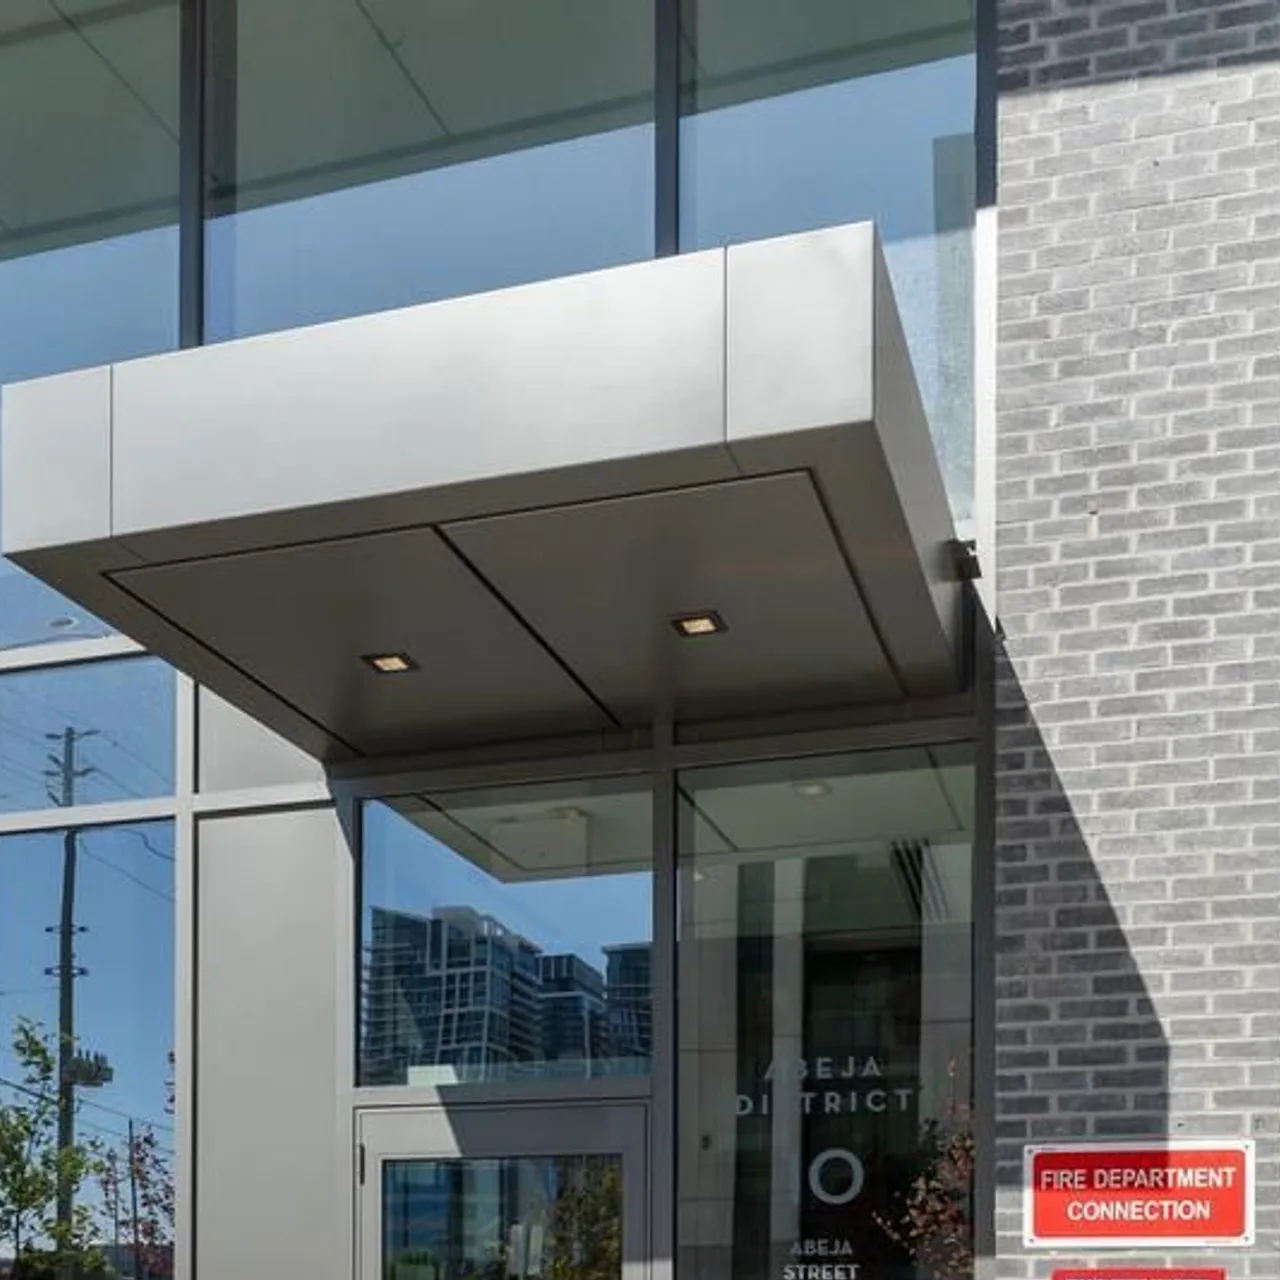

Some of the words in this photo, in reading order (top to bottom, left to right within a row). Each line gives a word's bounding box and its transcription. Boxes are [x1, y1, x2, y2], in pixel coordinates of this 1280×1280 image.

[735, 1089, 913, 1115] DITRICT
[1041, 1169, 1087, 1190] FIRE
[1094, 1167, 1236, 1189] DEPARTMENT
[1067, 1200, 1211, 1221] CONNECTION
[790, 1238, 853, 1256] ABEJA
[783, 1264, 860, 1280] STREET
